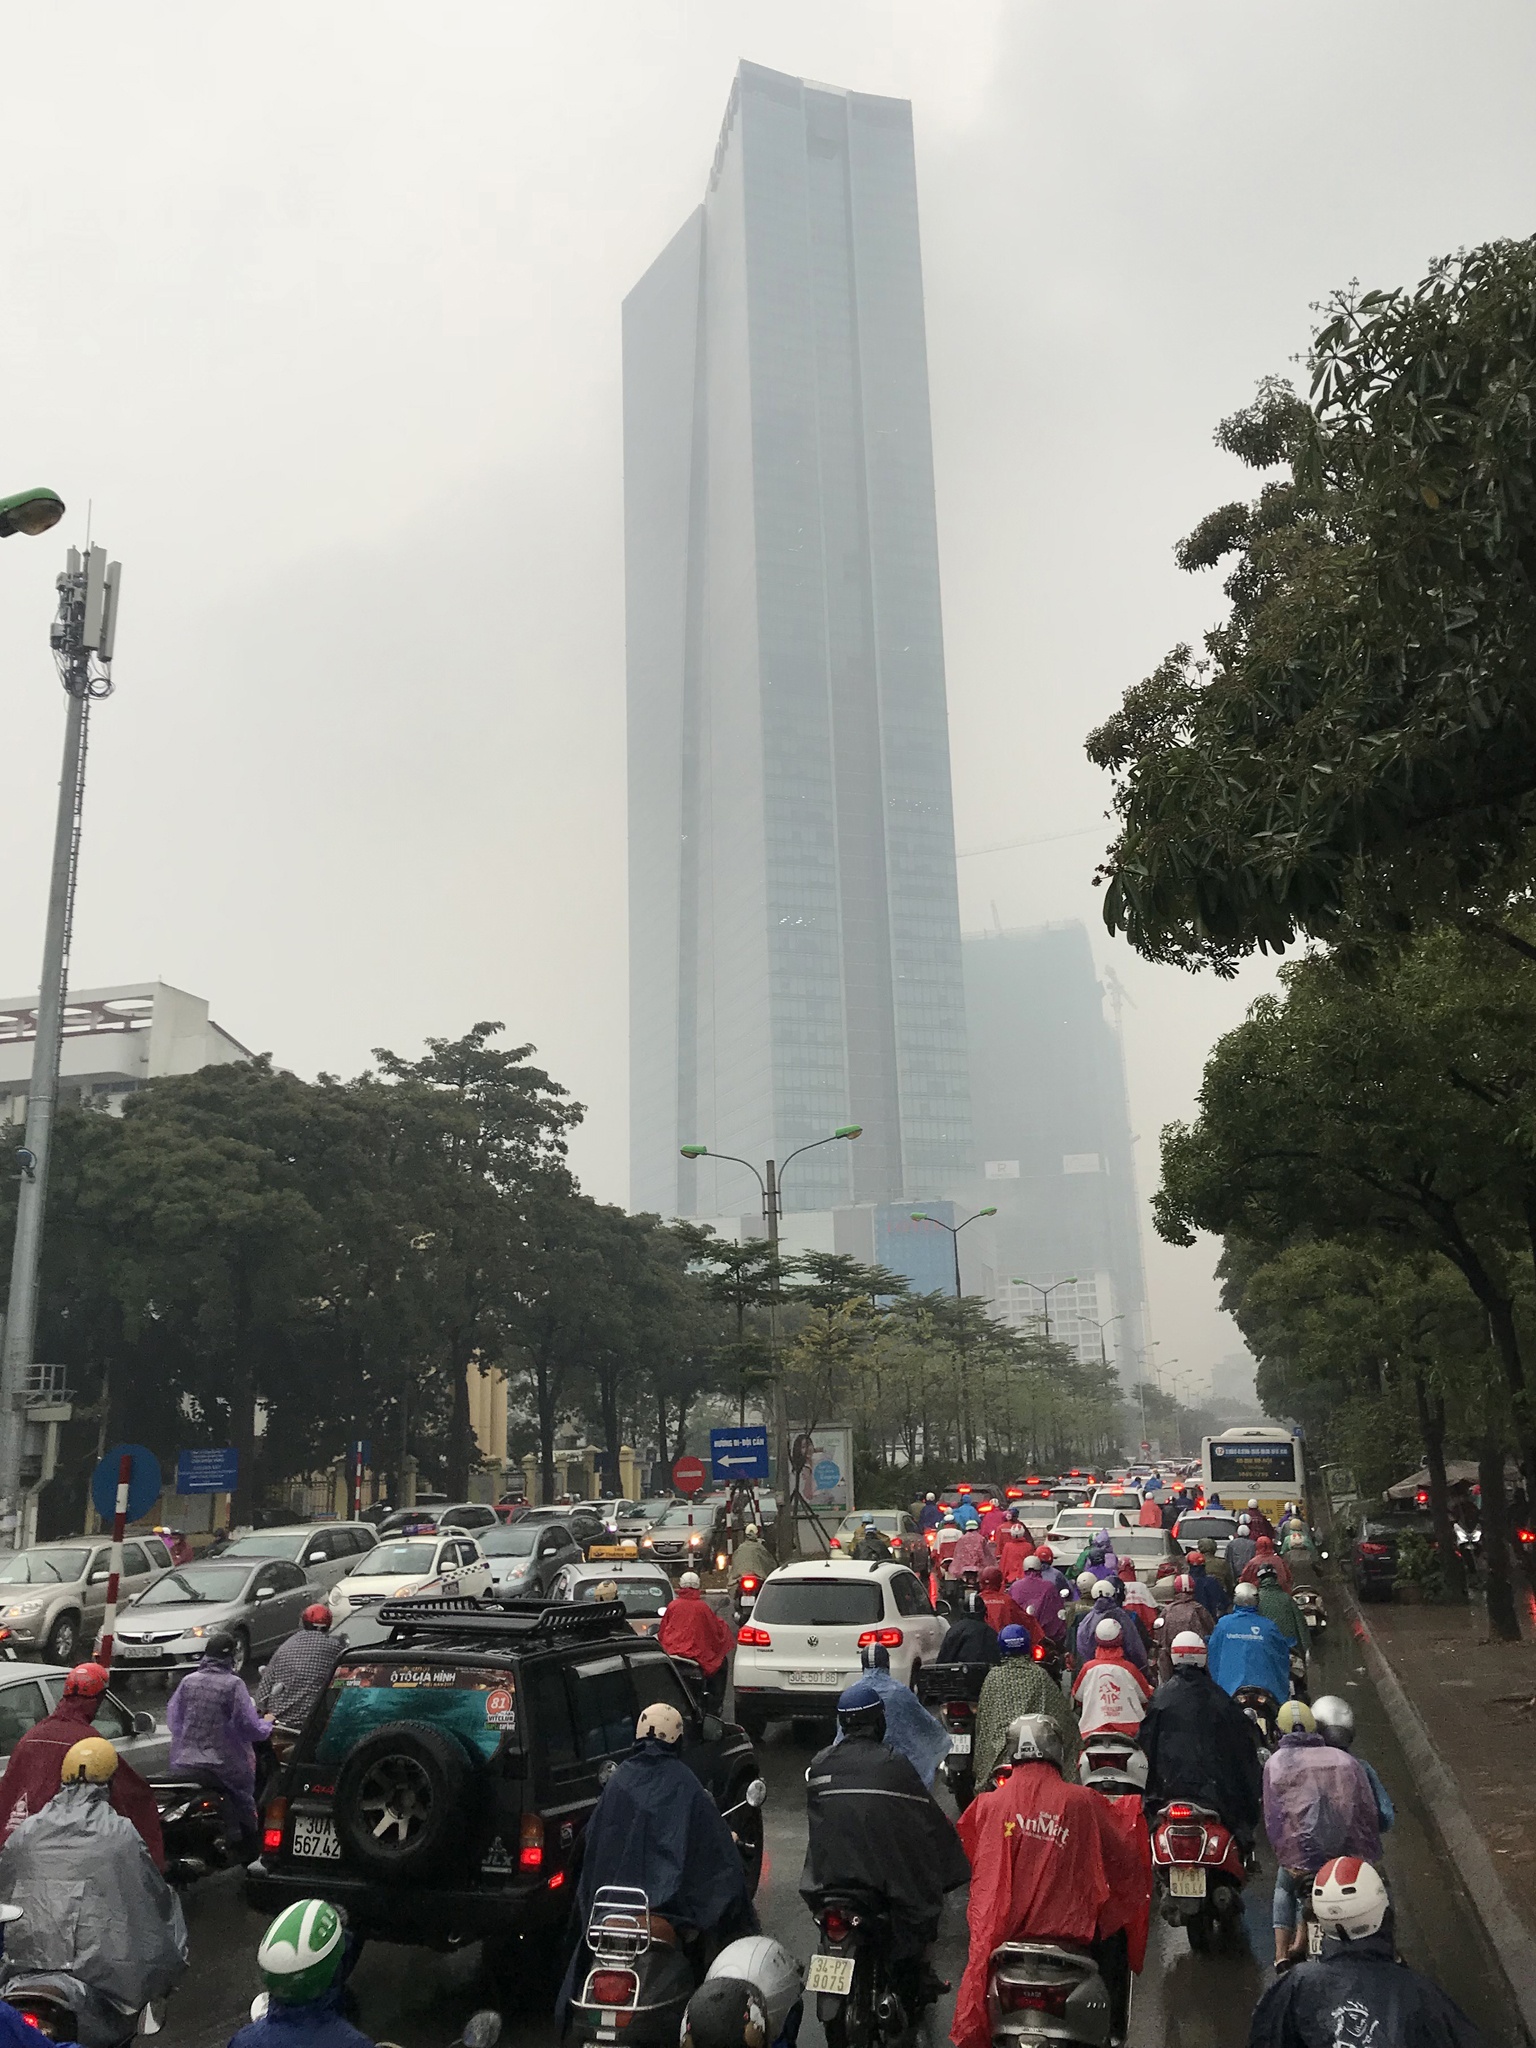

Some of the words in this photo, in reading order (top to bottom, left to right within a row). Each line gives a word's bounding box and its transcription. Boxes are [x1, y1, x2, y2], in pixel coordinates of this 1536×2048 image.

[490, 1696, 506, 1709] 81
[294, 1835, 340, 1857] 567.42
[815, 1958, 848, 1976] 34-P7
[812, 1973, 845, 1992] 9075
